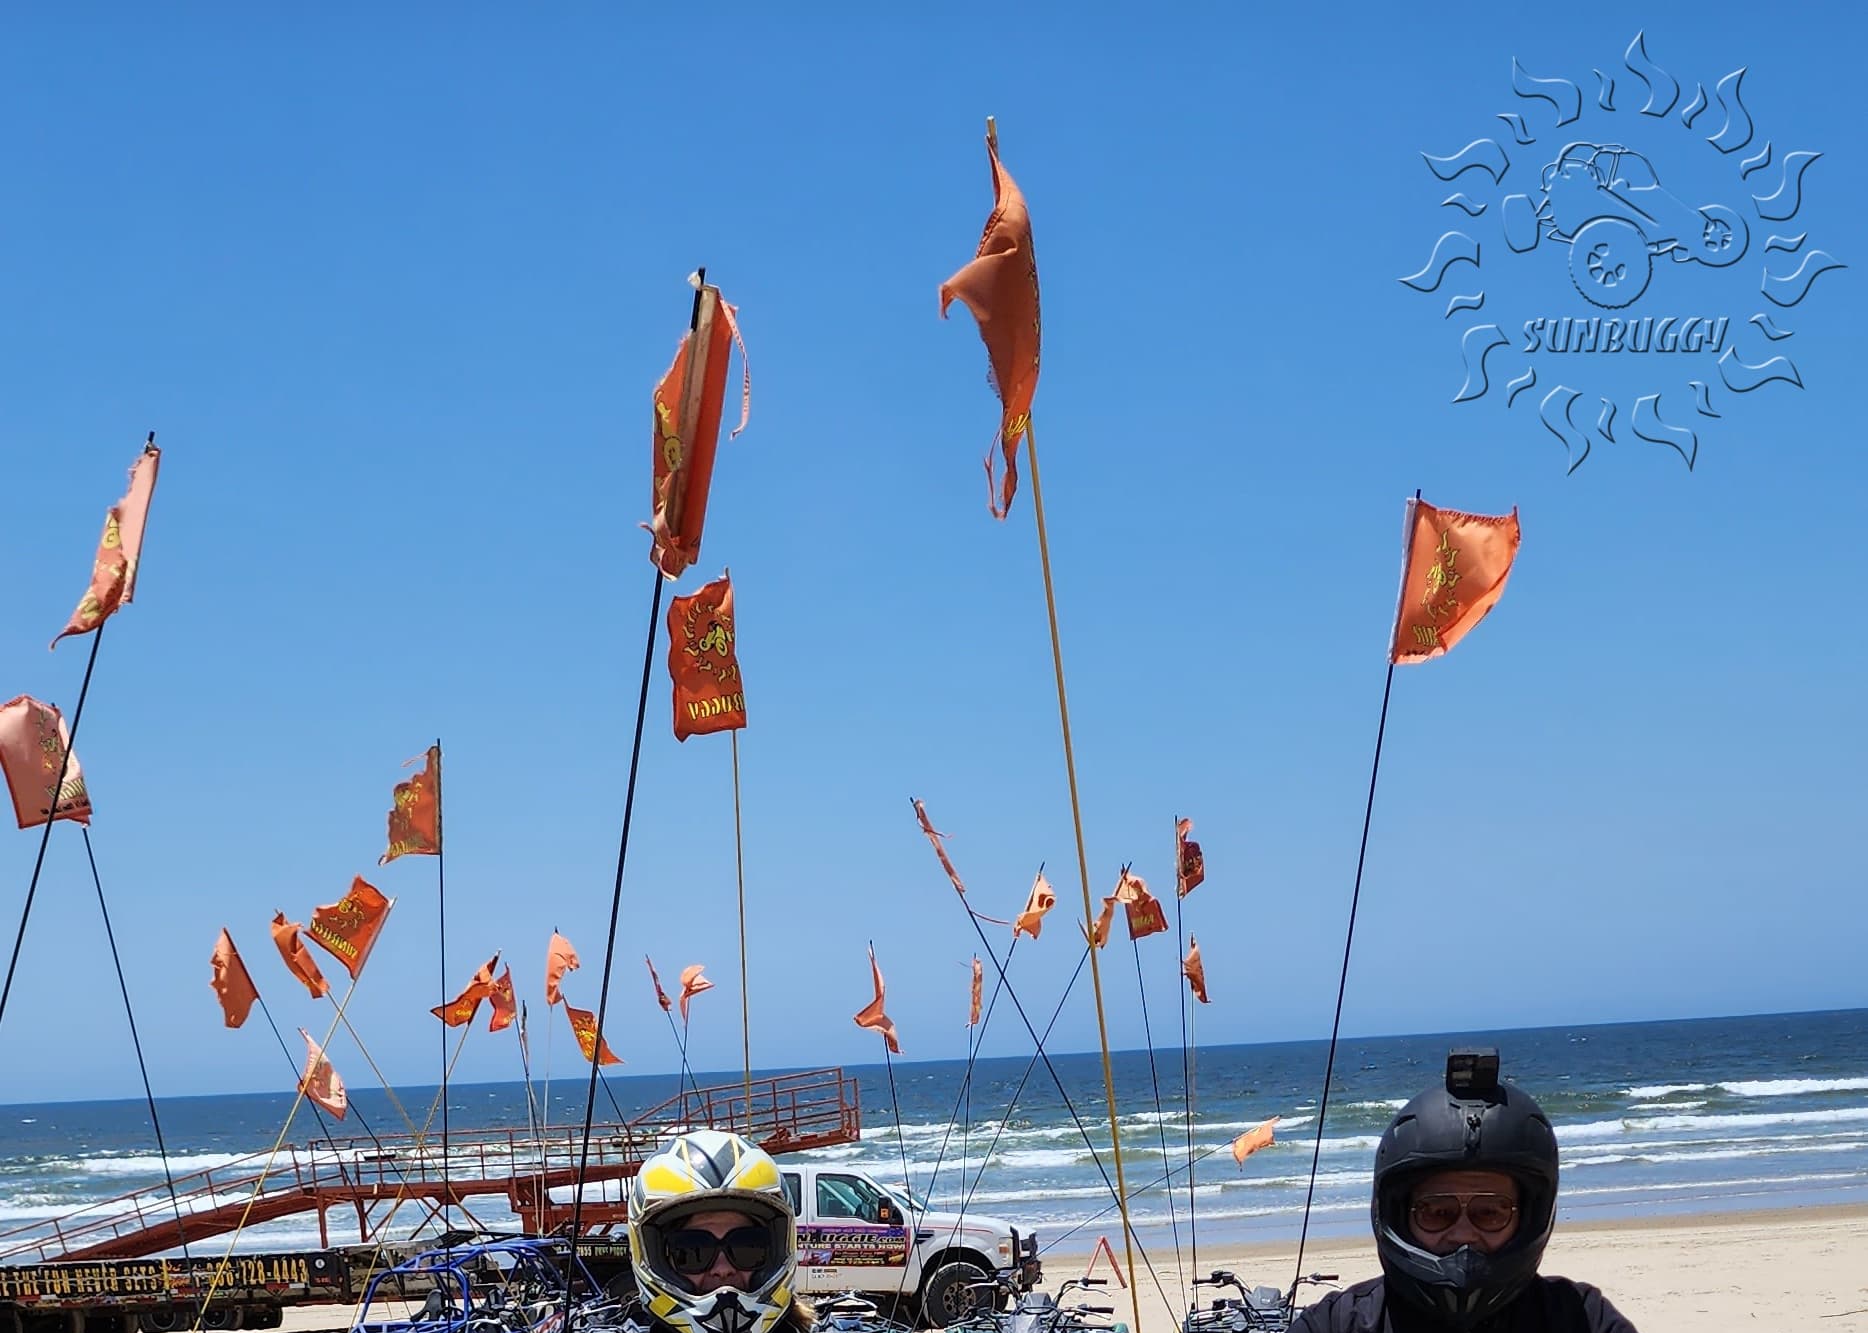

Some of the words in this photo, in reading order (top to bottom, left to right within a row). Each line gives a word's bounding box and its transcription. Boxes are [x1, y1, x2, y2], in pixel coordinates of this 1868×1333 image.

[12, 1271, 40, 1296] THE
[44, 1269, 71, 1295] FUN
[75, 1266, 119, 1293] NEVER
[123, 1265, 158, 1292] SETS
